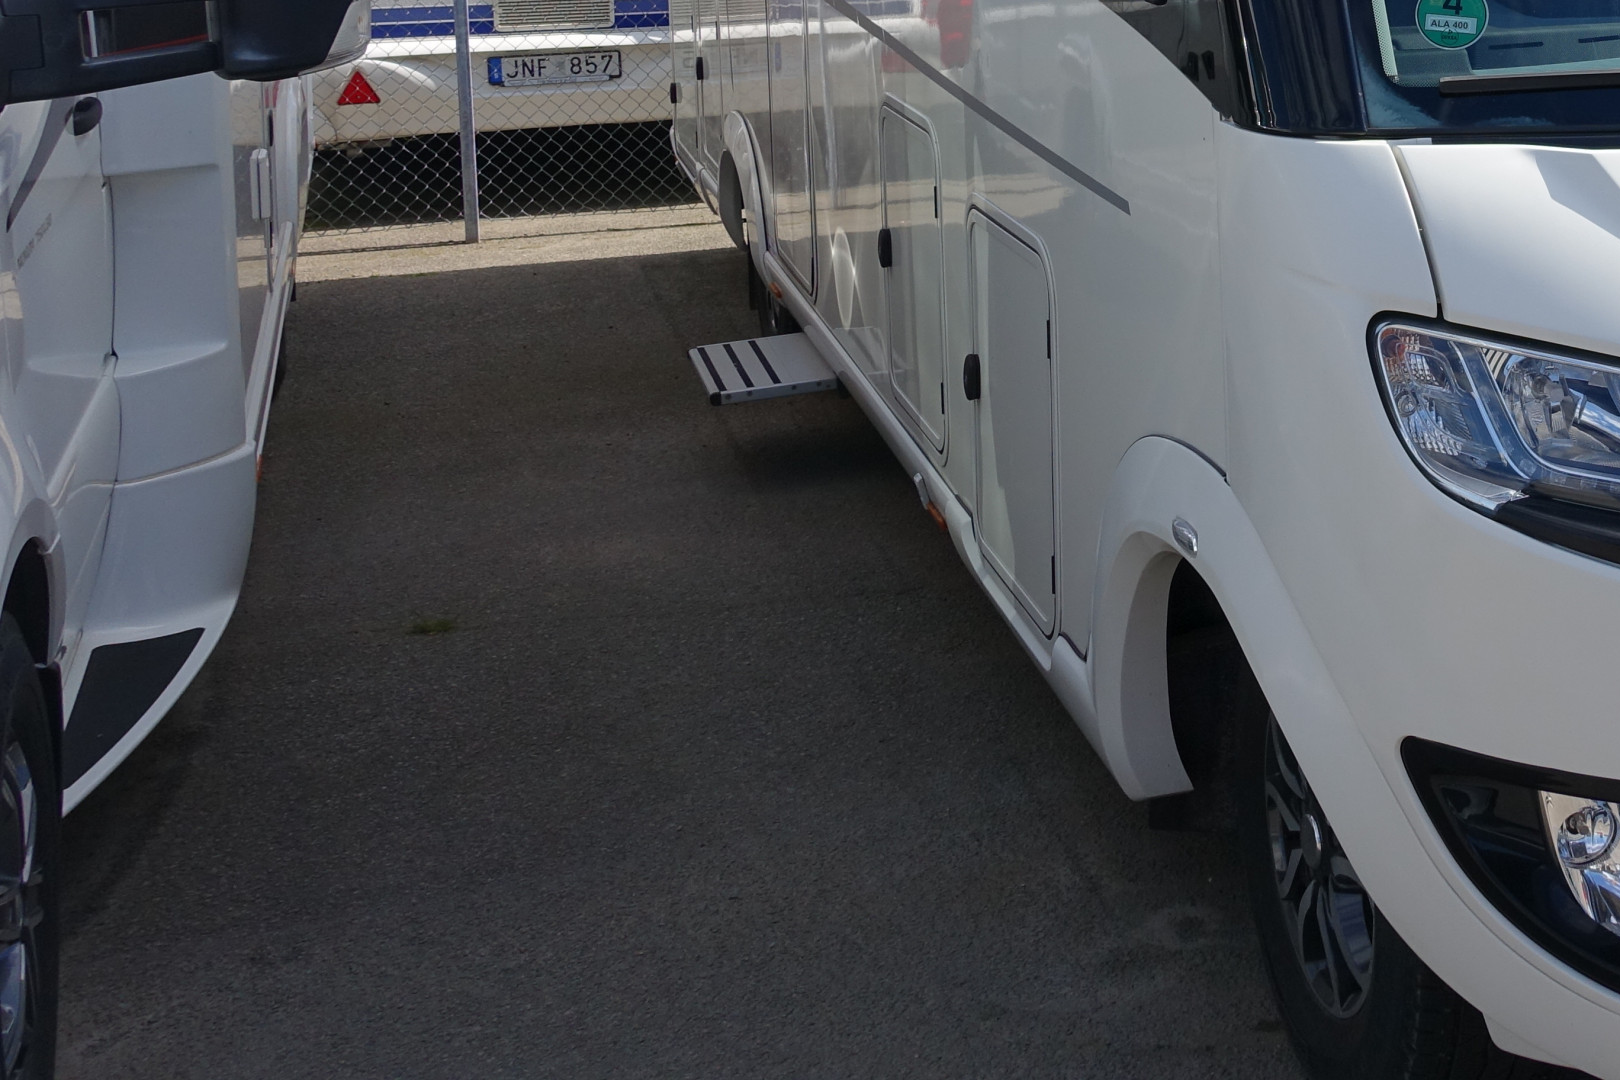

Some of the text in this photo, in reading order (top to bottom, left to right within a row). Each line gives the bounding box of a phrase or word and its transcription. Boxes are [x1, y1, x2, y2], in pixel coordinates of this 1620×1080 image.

[1430, 19, 1469, 30] ALA 400
[506, 54, 613, 79] JNF 857
